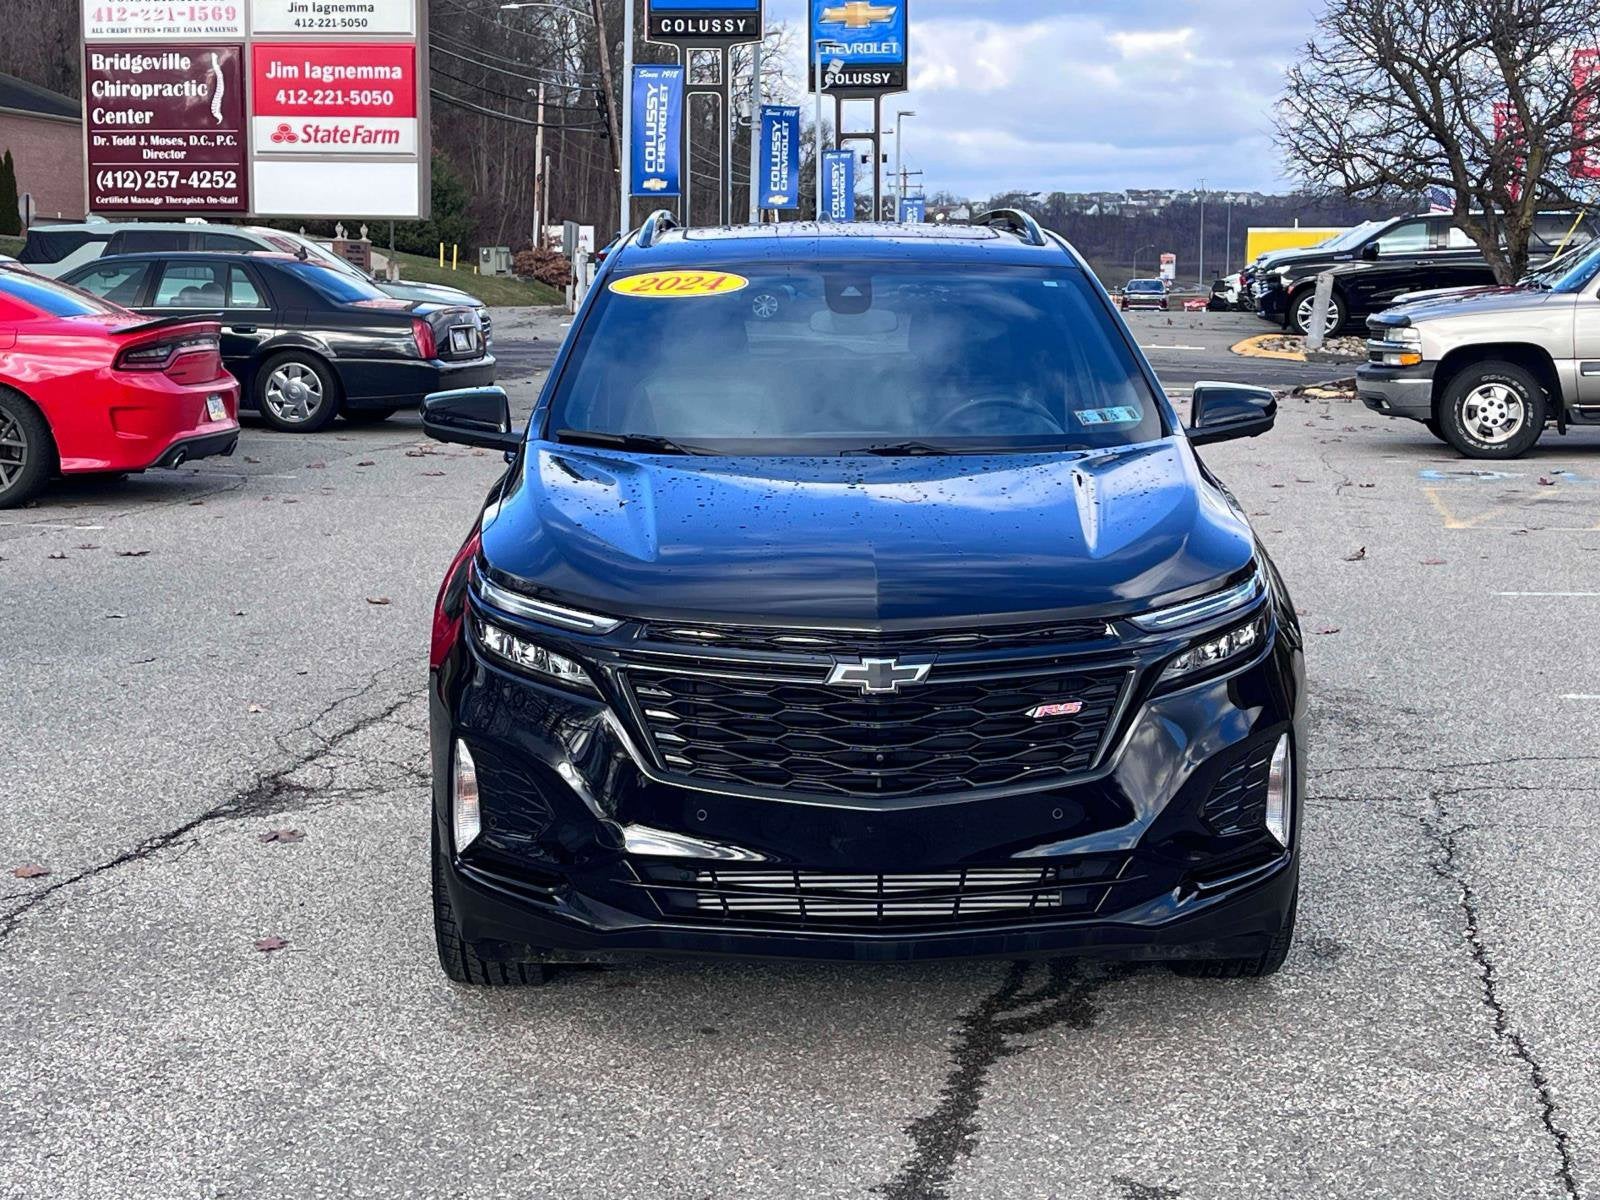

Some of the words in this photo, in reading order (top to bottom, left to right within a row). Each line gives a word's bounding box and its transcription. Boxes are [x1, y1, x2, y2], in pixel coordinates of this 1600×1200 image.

[91, 6, 237, 22] 412-221-1569
[287, 2, 309, 13] Jim
[294, 18, 368, 28] 412-221-5050
[661, 19, 746, 32] COLUSSY
[91, 53, 191, 74] Bridgeville
[265, 61, 299, 79] Jim
[824, 73, 891, 85] COLUSSY
[91, 80, 208, 100] Chiropractic
[275, 89, 394, 105] 412-221-5050
[92, 107, 154, 124] Center
[645, 83, 659, 173] COLUSSY
[656, 83, 669, 173] CHEVROLET
[93, 135, 110, 146] Dr.
[111, 135, 136, 146] Todd
[139, 135, 148, 146] J.
[150, 135, 187, 147] Moses,
[216, 135, 238, 146] P.C.
[142, 149, 187, 159] Director
[771, 120, 782, 191] COLUSSY
[780, 120, 790, 191] CHEVROLET
[831, 162, 840, 218] COLUSSY
[95, 196, 129, 204] Certified
[130, 196, 163, 205] Massage
[165, 196, 205, 205] Therapists
[206, 196, 239, 204] On-Staff
[630, 276, 727, 292] 2024
[1032, 701, 1083, 718] RS
